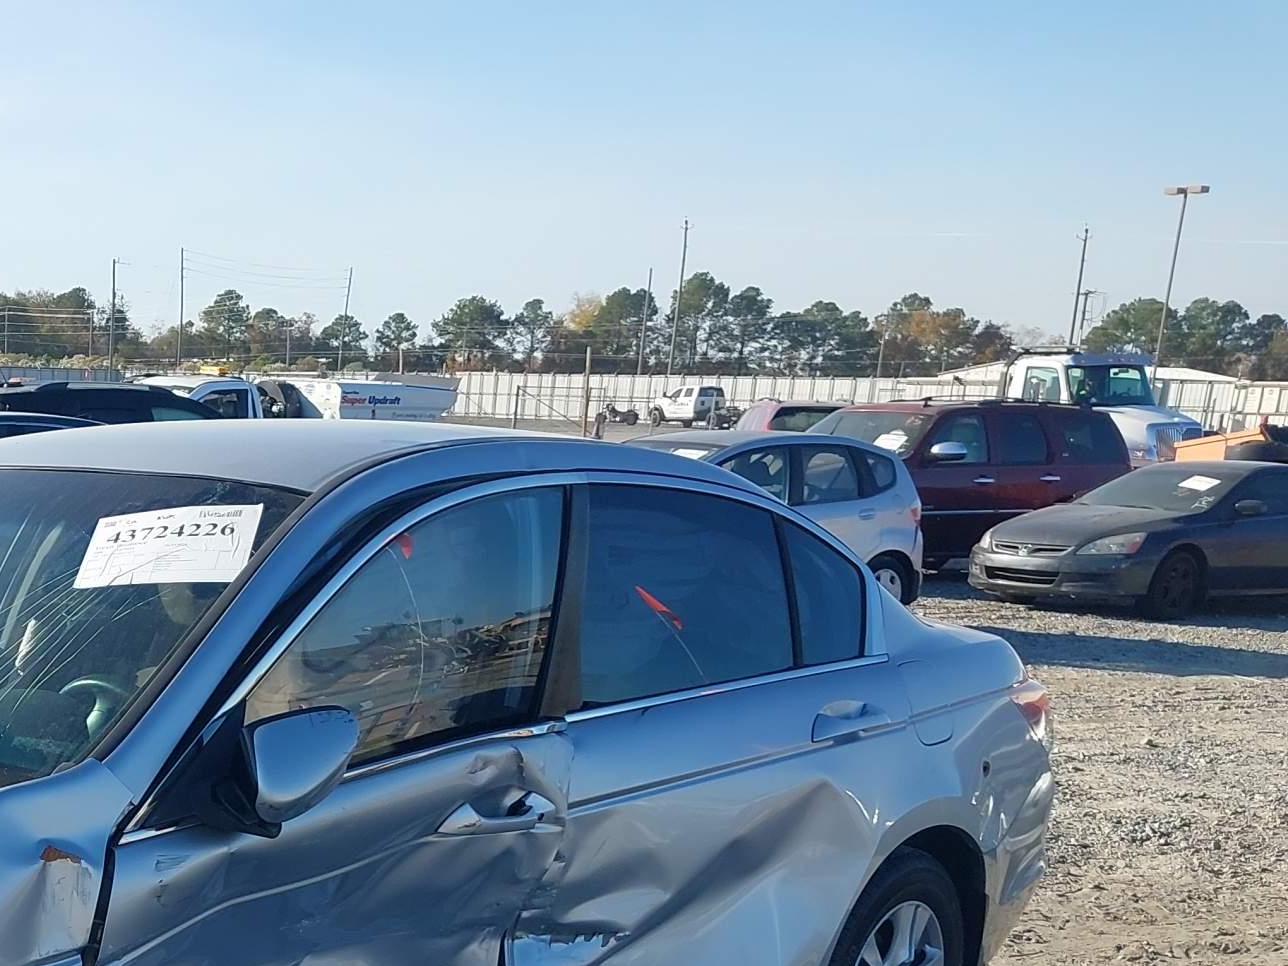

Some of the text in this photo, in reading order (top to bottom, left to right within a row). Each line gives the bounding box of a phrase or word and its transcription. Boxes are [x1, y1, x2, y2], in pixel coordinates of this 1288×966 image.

[341, 396, 401, 406] Super Updraft
[106, 523, 237, 544] 43724226
